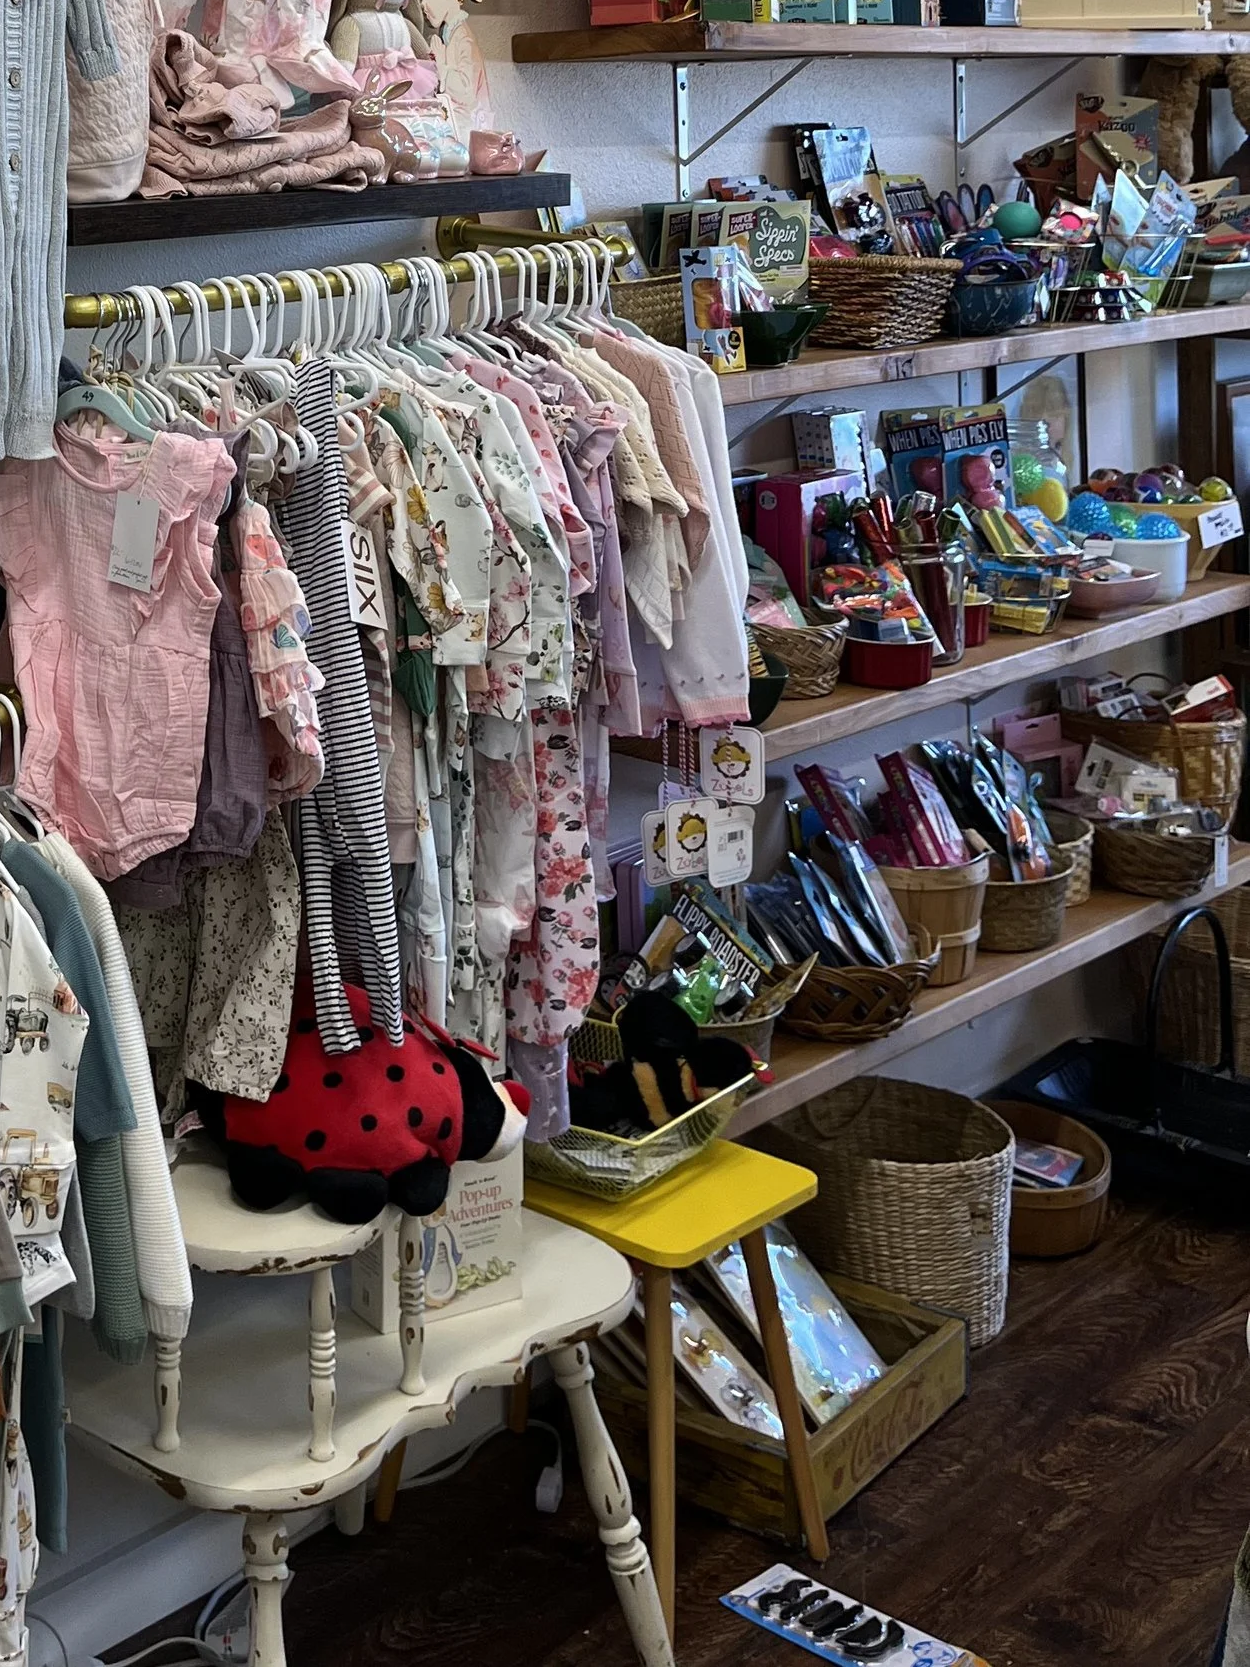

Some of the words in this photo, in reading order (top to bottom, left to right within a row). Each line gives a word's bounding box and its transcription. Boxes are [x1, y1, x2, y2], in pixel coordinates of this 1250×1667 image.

[755, 217, 799, 247] Sippin'
[754, 244, 796, 268] Specs
[81, 390, 95, 403] 49
[941, 427, 968, 452] WHEN
[969, 423, 988, 444] PIGS
[989, 419, 1005, 441] FLY
[675, 852, 709, 871] Zubel
[672, 894, 712, 933] FLIPPY
[710, 926, 761, 991] ROADSTER
[459, 1185, 501, 1205] Pop-up
[449, 1198, 514, 1224] Adventures
